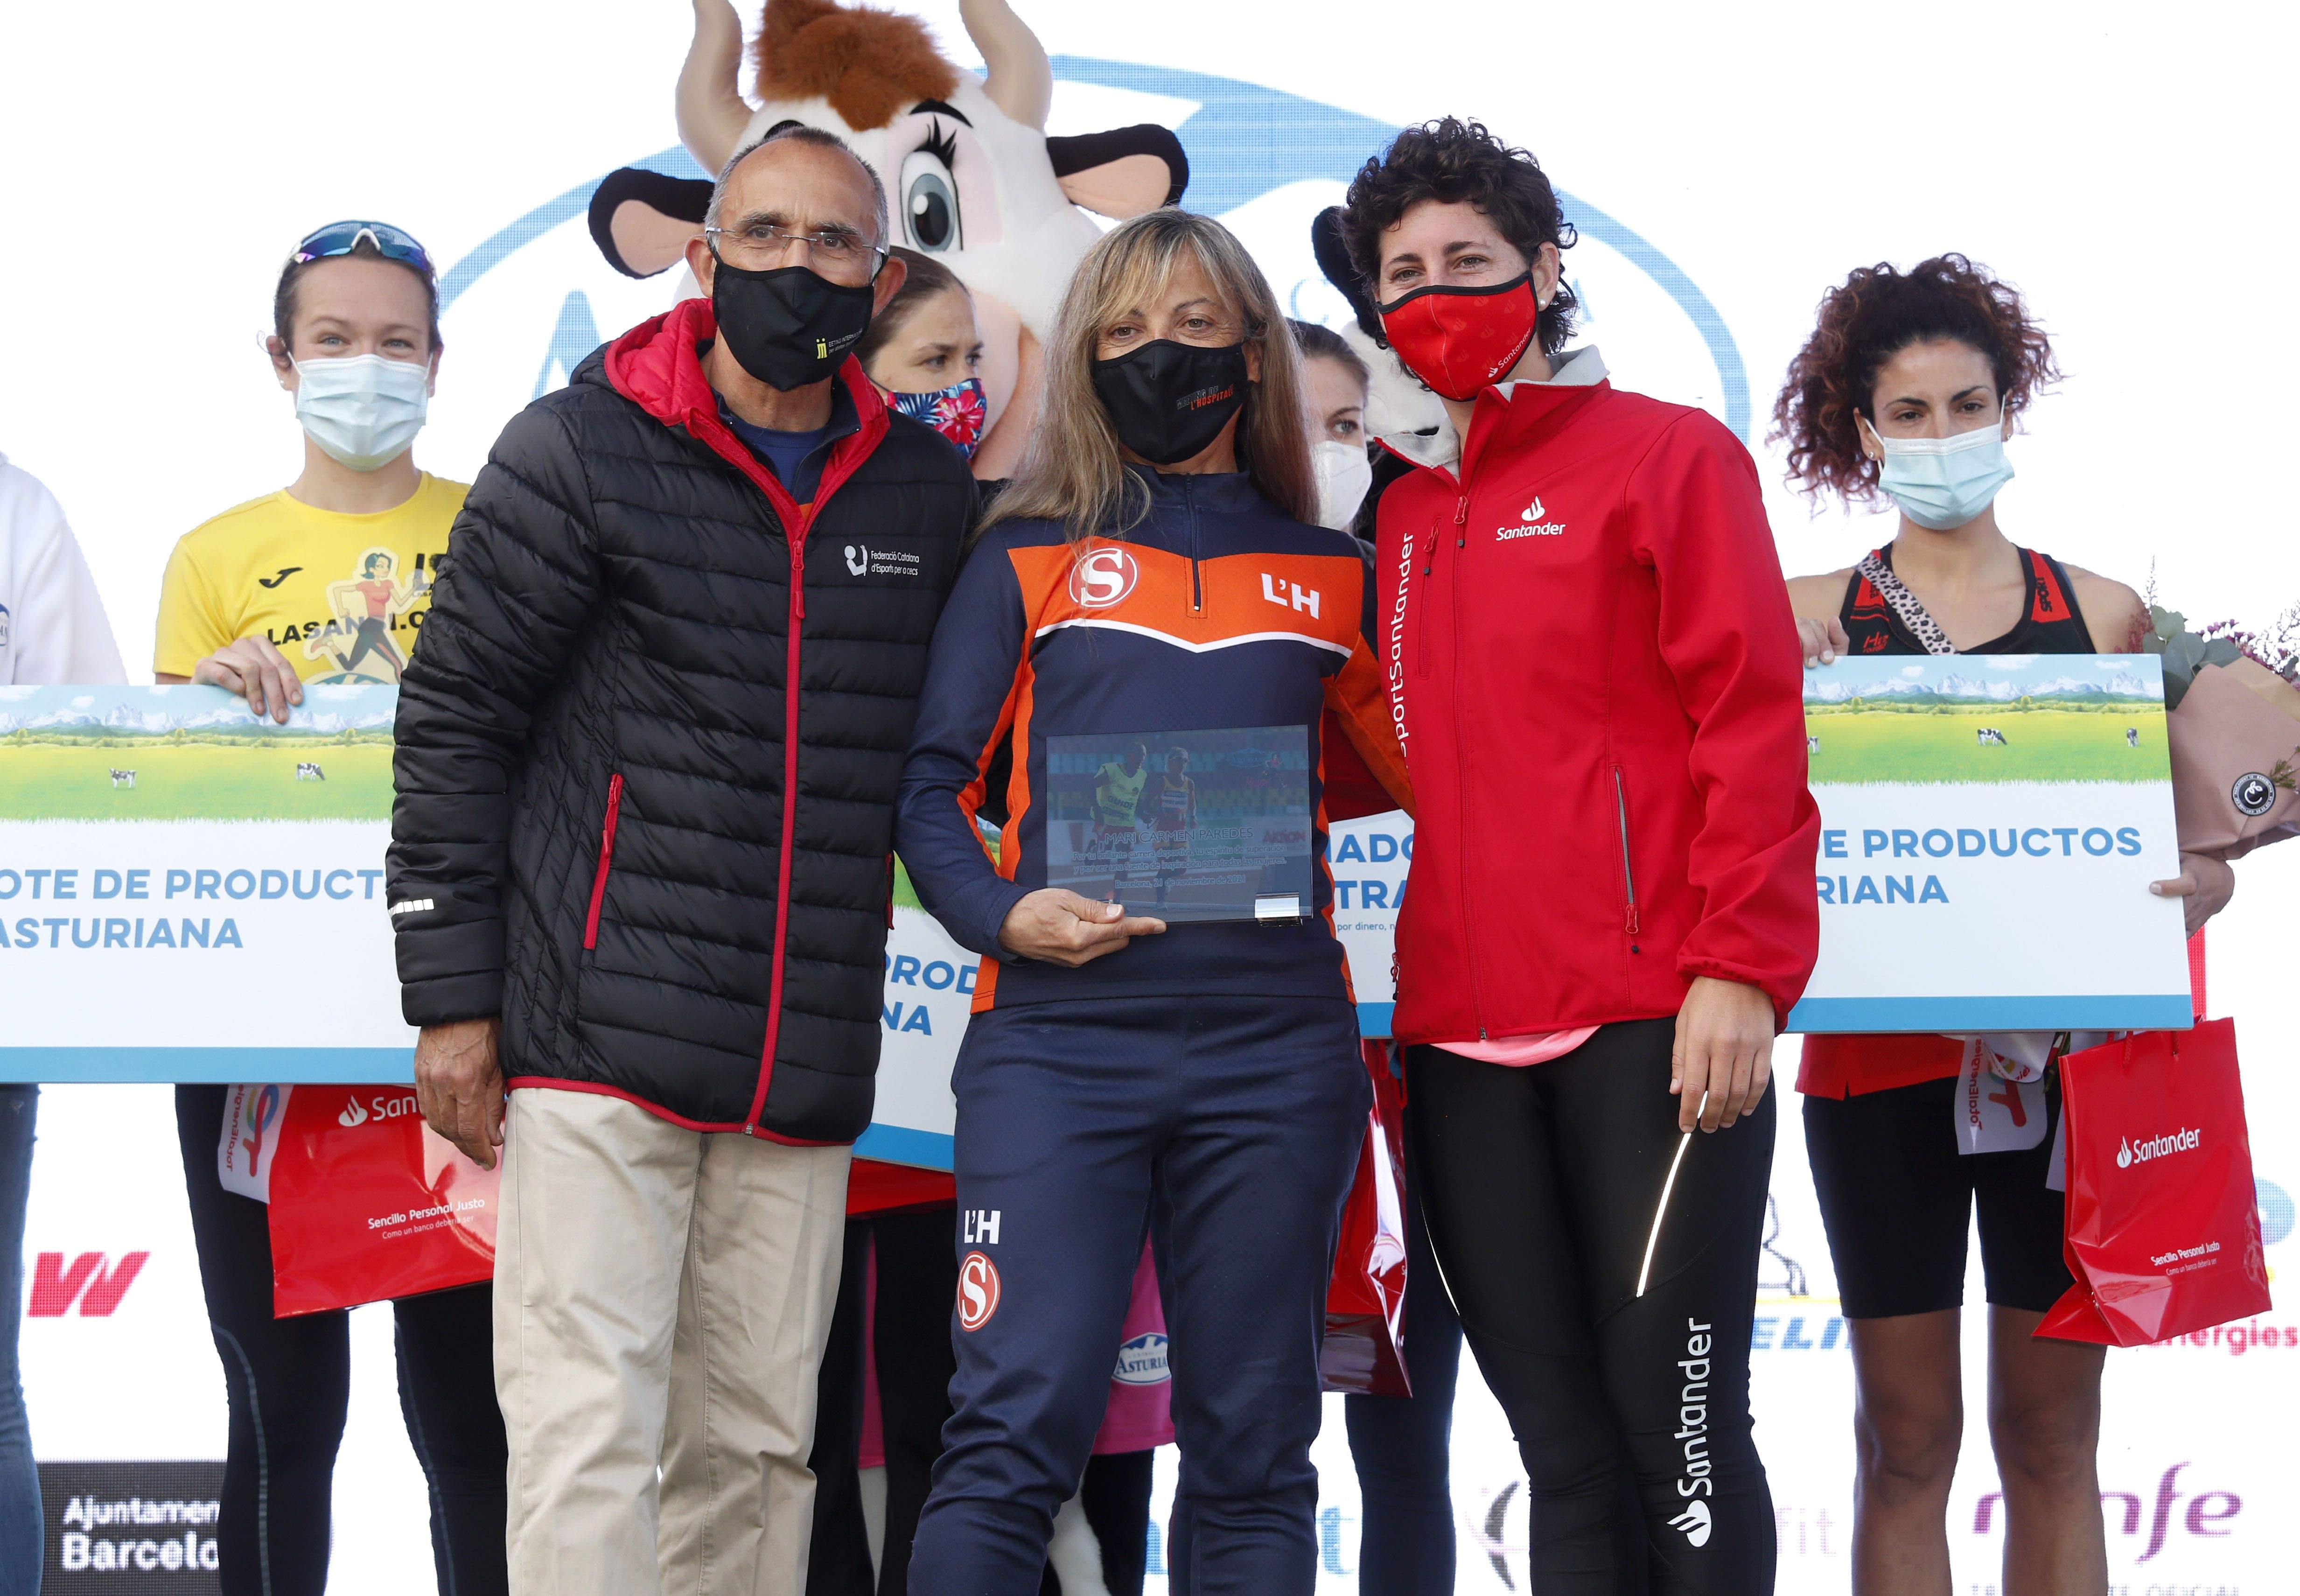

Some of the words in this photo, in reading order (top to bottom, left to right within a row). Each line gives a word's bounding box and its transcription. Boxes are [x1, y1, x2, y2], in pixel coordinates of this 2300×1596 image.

[1497, 327, 1531, 369] Santander
[1496, 522, 1566, 541] Santander
[871, 550, 897, 561] Federació
[897, 552, 920, 563] Catalana
[871, 563, 894, 574] d'Esports
[907, 567, 918, 576] cecs
[1105, 833, 1136, 844] MARI
[1140, 830, 1195, 842] CARMEN
[1199, 828, 1253, 840] PAREDES
[1863, 827, 2142, 859] PRODUCTOS
[1073, 852, 1087, 861] Por
[1098, 850, 1127, 860] brillante
[1129, 849, 1155, 858] carrera
[1157, 847, 1194, 859] deportiva,
[1196, 847, 1203, 855] tu
[1234, 843, 1244, 853] de
[1246, 843, 1287, 854] superación
[1074, 866, 1080, 875] y
[1081, 864, 1094, 874] por
[1096, 863, 1110, 873] ser
[1110, 862, 1124, 871] una
[1125, 861, 1149, 871] fuente
[1150, 861, 1160, 869] de
[1162, 859, 1200, 871] inspiración
[1202, 860, 1220, 869] para
[1220, 857, 1241, 867] todas
[1243, 856, 1253, 866] las
[1255, 856, 1286, 867] mujeres.
[94, 869, 151, 900] DE
[165, 869, 384, 900] PRODUCT
[1115, 880, 1152, 889] Barcelona,
[1154, 878, 1163, 887] 21
[1165, 877, 1176, 887] de
[1177, 876, 1215, 886] noviembre
[1216, 875, 1226, 884] de
[1228, 875, 1245, 884] 2021
[1337, 923, 1351, 931] por
[1355, 920, 1387, 931] dinero,
[2133, 1127, 2200, 1164] Santander
[368, 1212, 406, 1230] Sencillo
[409, 1202, 453, 1220] Personal
[456, 1198, 485, 1211] Justo
[382, 1229, 402, 1239] Como
[413, 1222, 434, 1233] banco
[462, 1215, 474, 1223] ser
[964, 1210, 1001, 1244] L'H
[2151, 1252, 2178, 1266] Sencillo
[2177, 1243, 2205, 1259] Personal
[2205, 1241, 2220, 1253] Justo
[1674, 1317, 1713, 1497] Santander
